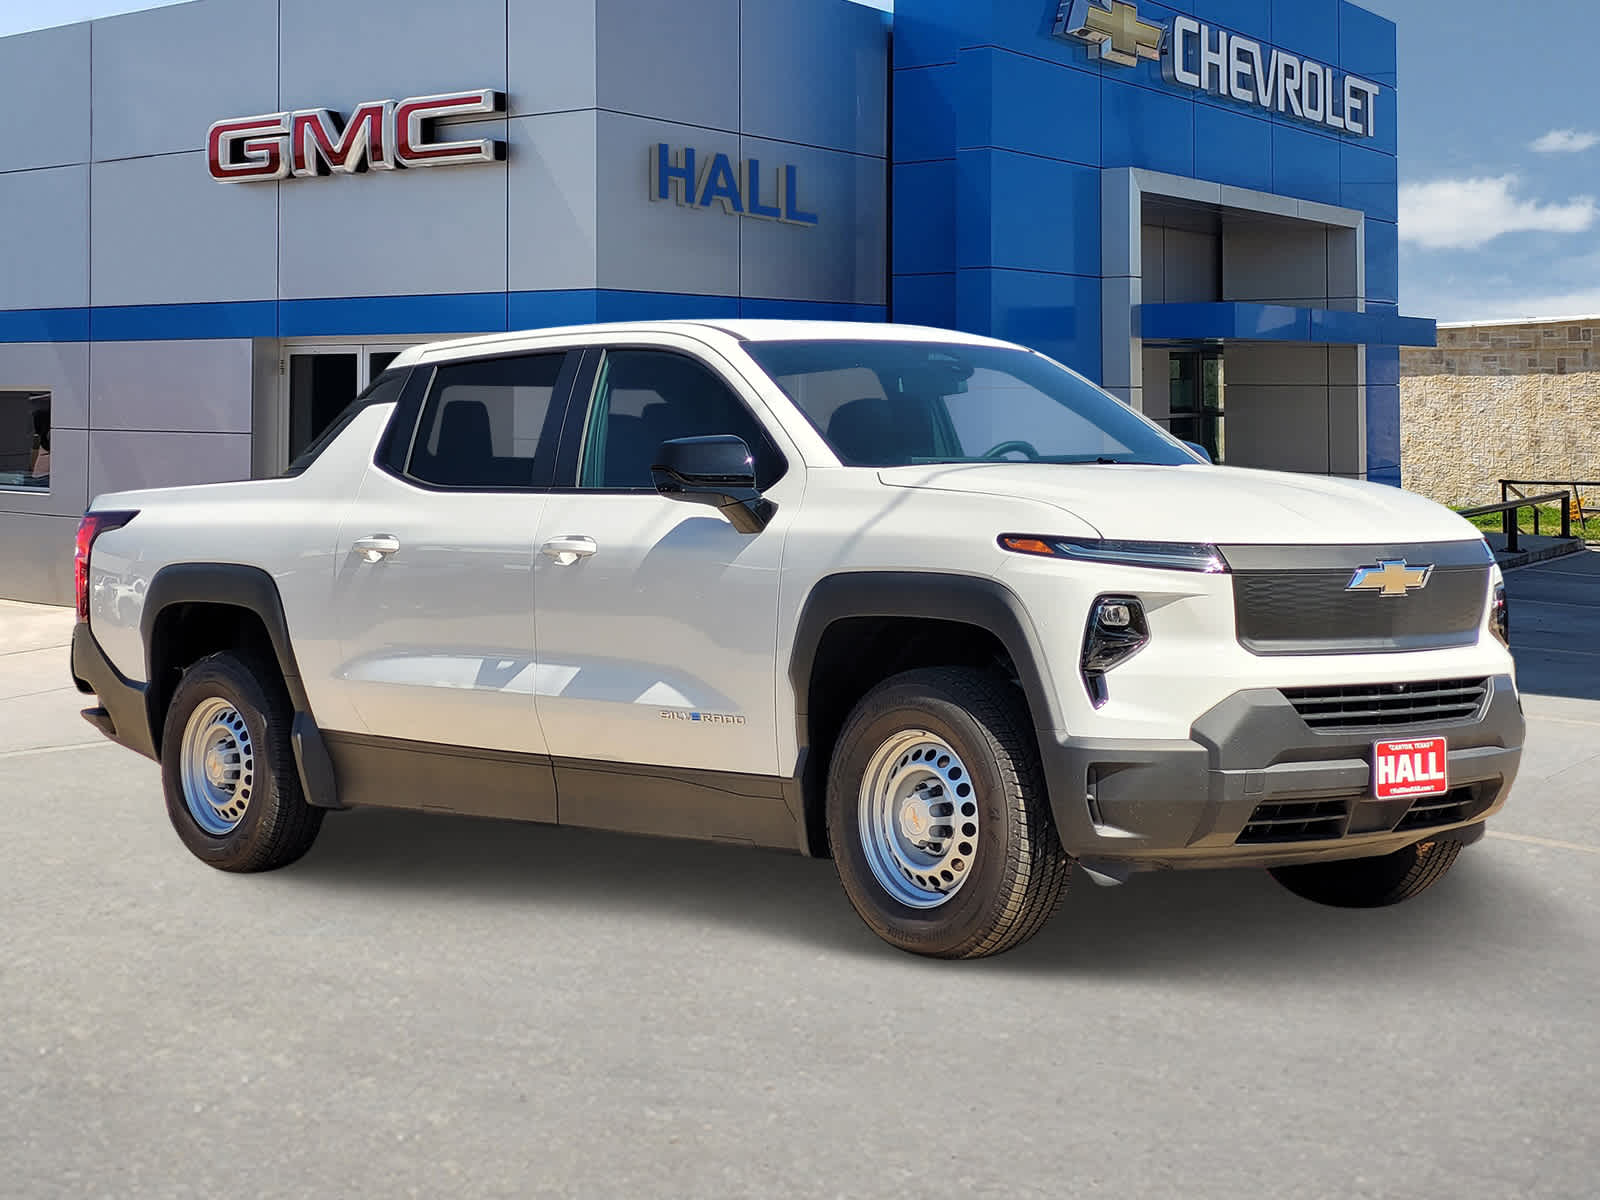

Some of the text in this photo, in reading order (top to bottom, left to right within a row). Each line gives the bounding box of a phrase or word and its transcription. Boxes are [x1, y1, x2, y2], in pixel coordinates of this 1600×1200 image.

[1174, 16, 1379, 136] CHEVROLET
[208, 88, 506, 183] GMC
[652, 143, 818, 226] HALL
[660, 710, 746, 724] SILVERADO
[1378, 752, 1444, 785] HALL
